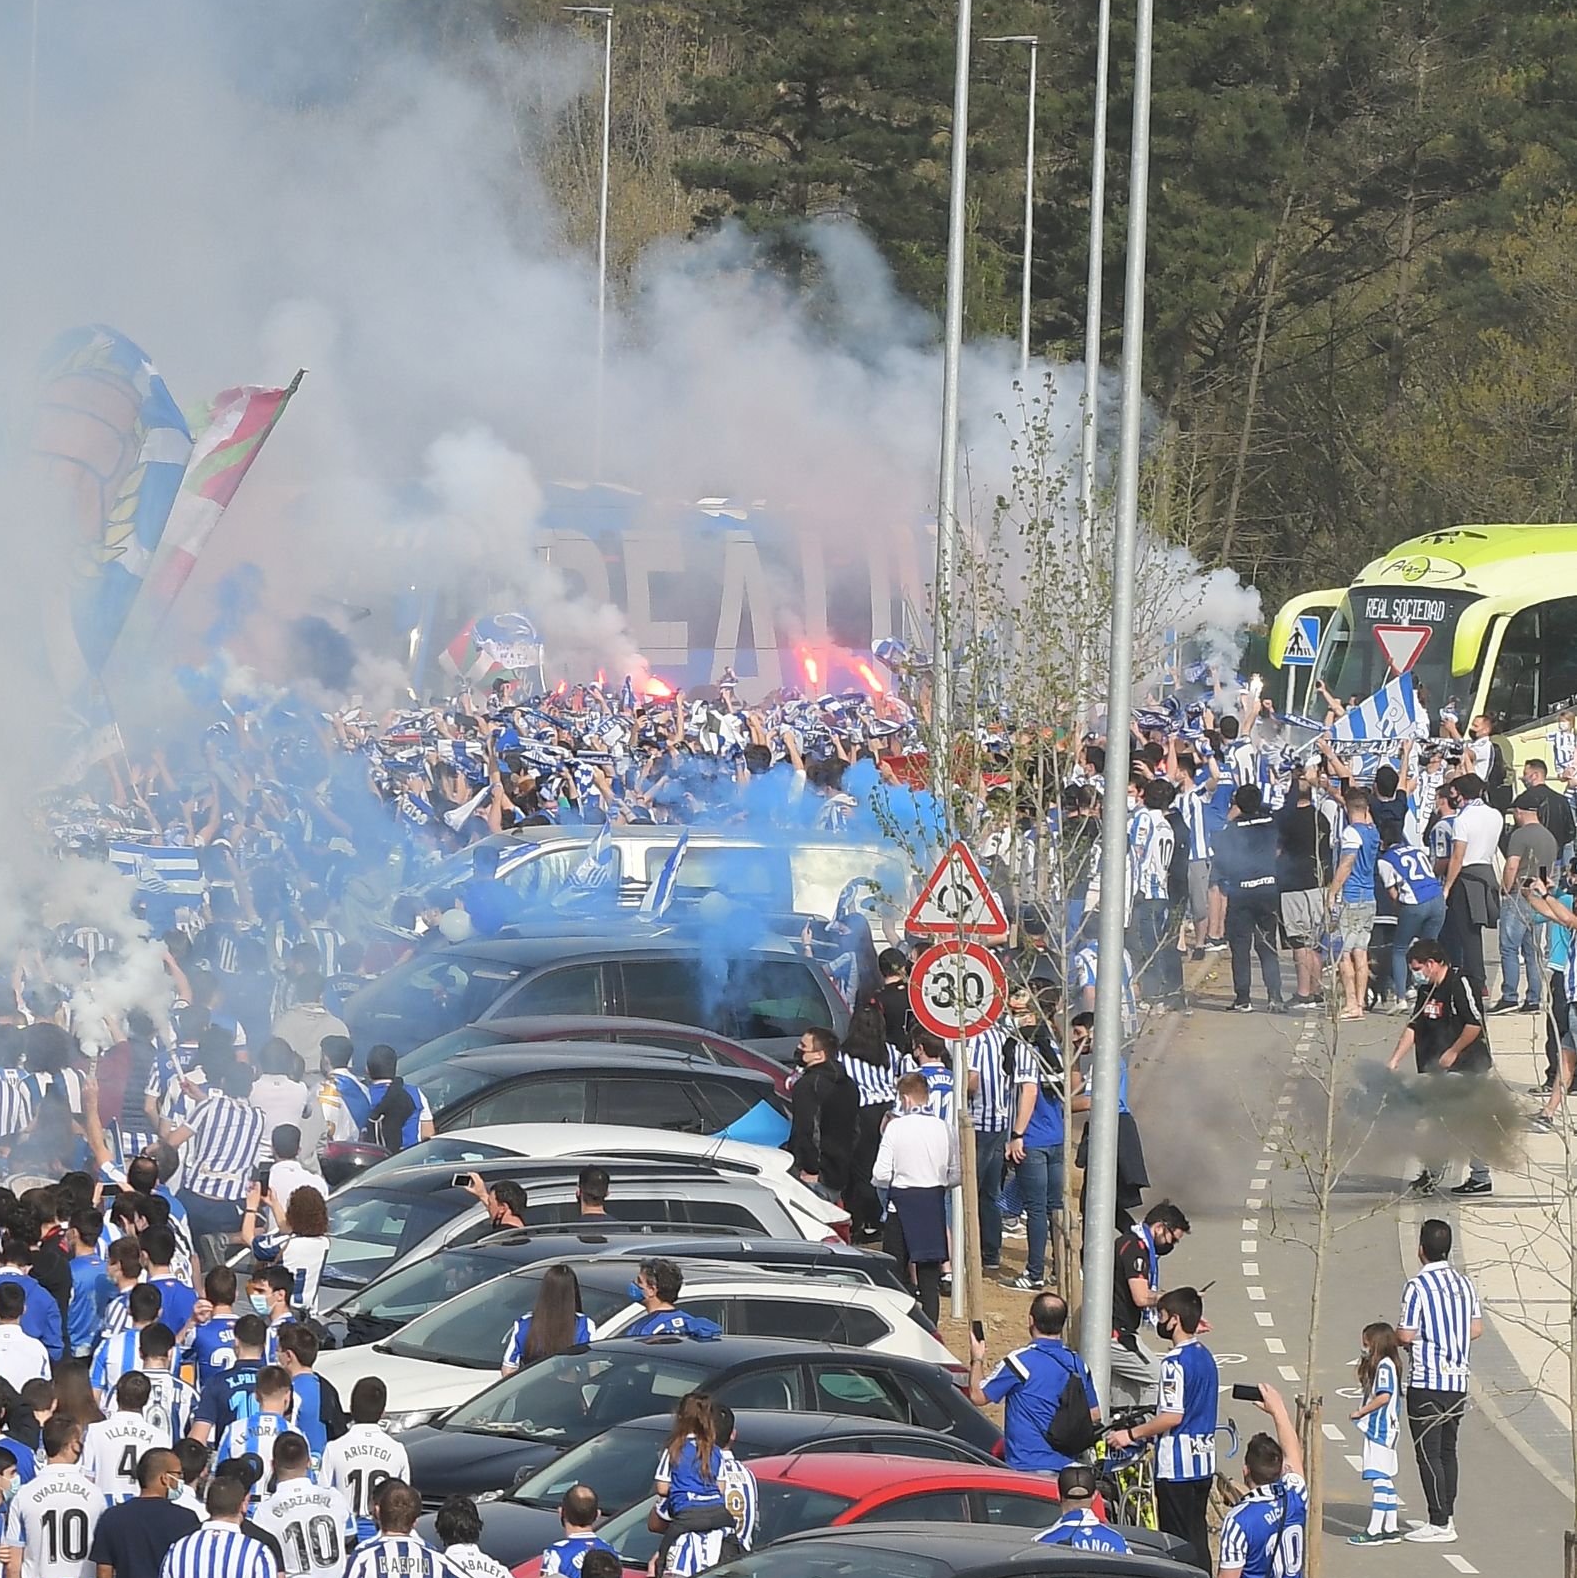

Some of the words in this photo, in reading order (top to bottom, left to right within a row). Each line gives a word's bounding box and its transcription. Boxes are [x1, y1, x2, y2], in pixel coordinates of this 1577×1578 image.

[1365, 598, 1388, 619] REAL
[1391, 598, 1445, 622] SOCIEDAD
[1159, 838, 1173, 872] 10
[1401, 850, 1434, 881] 20
[930, 972, 985, 1009] 30
[105, 1427, 154, 1446] ILLARRA
[117, 1444, 142, 1485] 4
[343, 1444, 392, 1464] ARISTEGI
[32, 1482, 91, 1504] OYARZABAL
[271, 1495, 332, 1519] OYARZABAL
[40, 1508, 89, 1565] 10
[285, 1514, 341, 1574] 10
[379, 1556, 430, 1575] KARPIN
